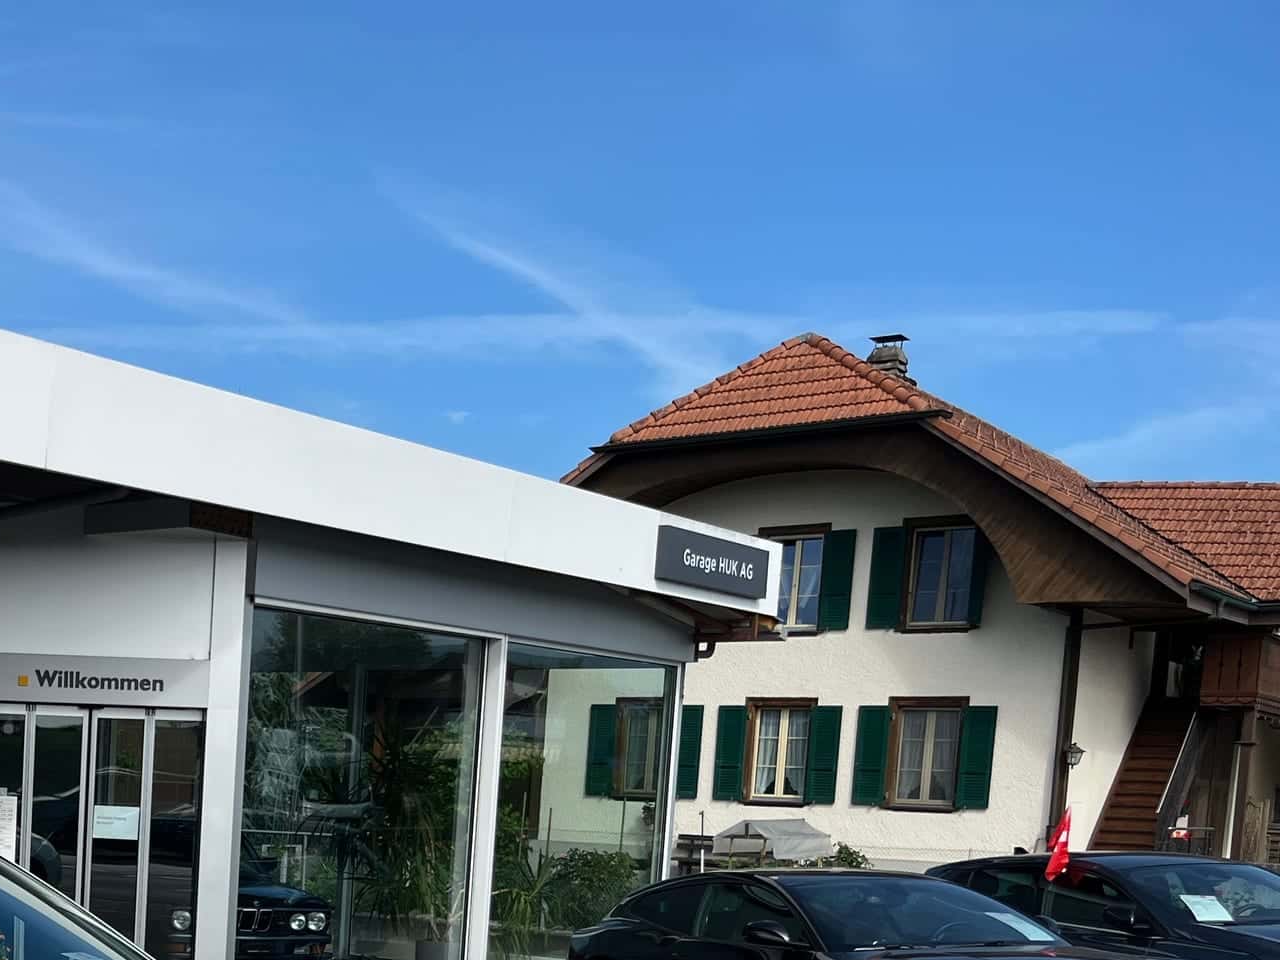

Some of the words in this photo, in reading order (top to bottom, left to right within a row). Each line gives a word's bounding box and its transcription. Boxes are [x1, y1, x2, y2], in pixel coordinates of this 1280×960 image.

[683, 548, 717, 573] Garage
[718, 556, 738, 577] HUK
[739, 562, 753, 580] AG
[35, 669, 164, 692] Willkommen
